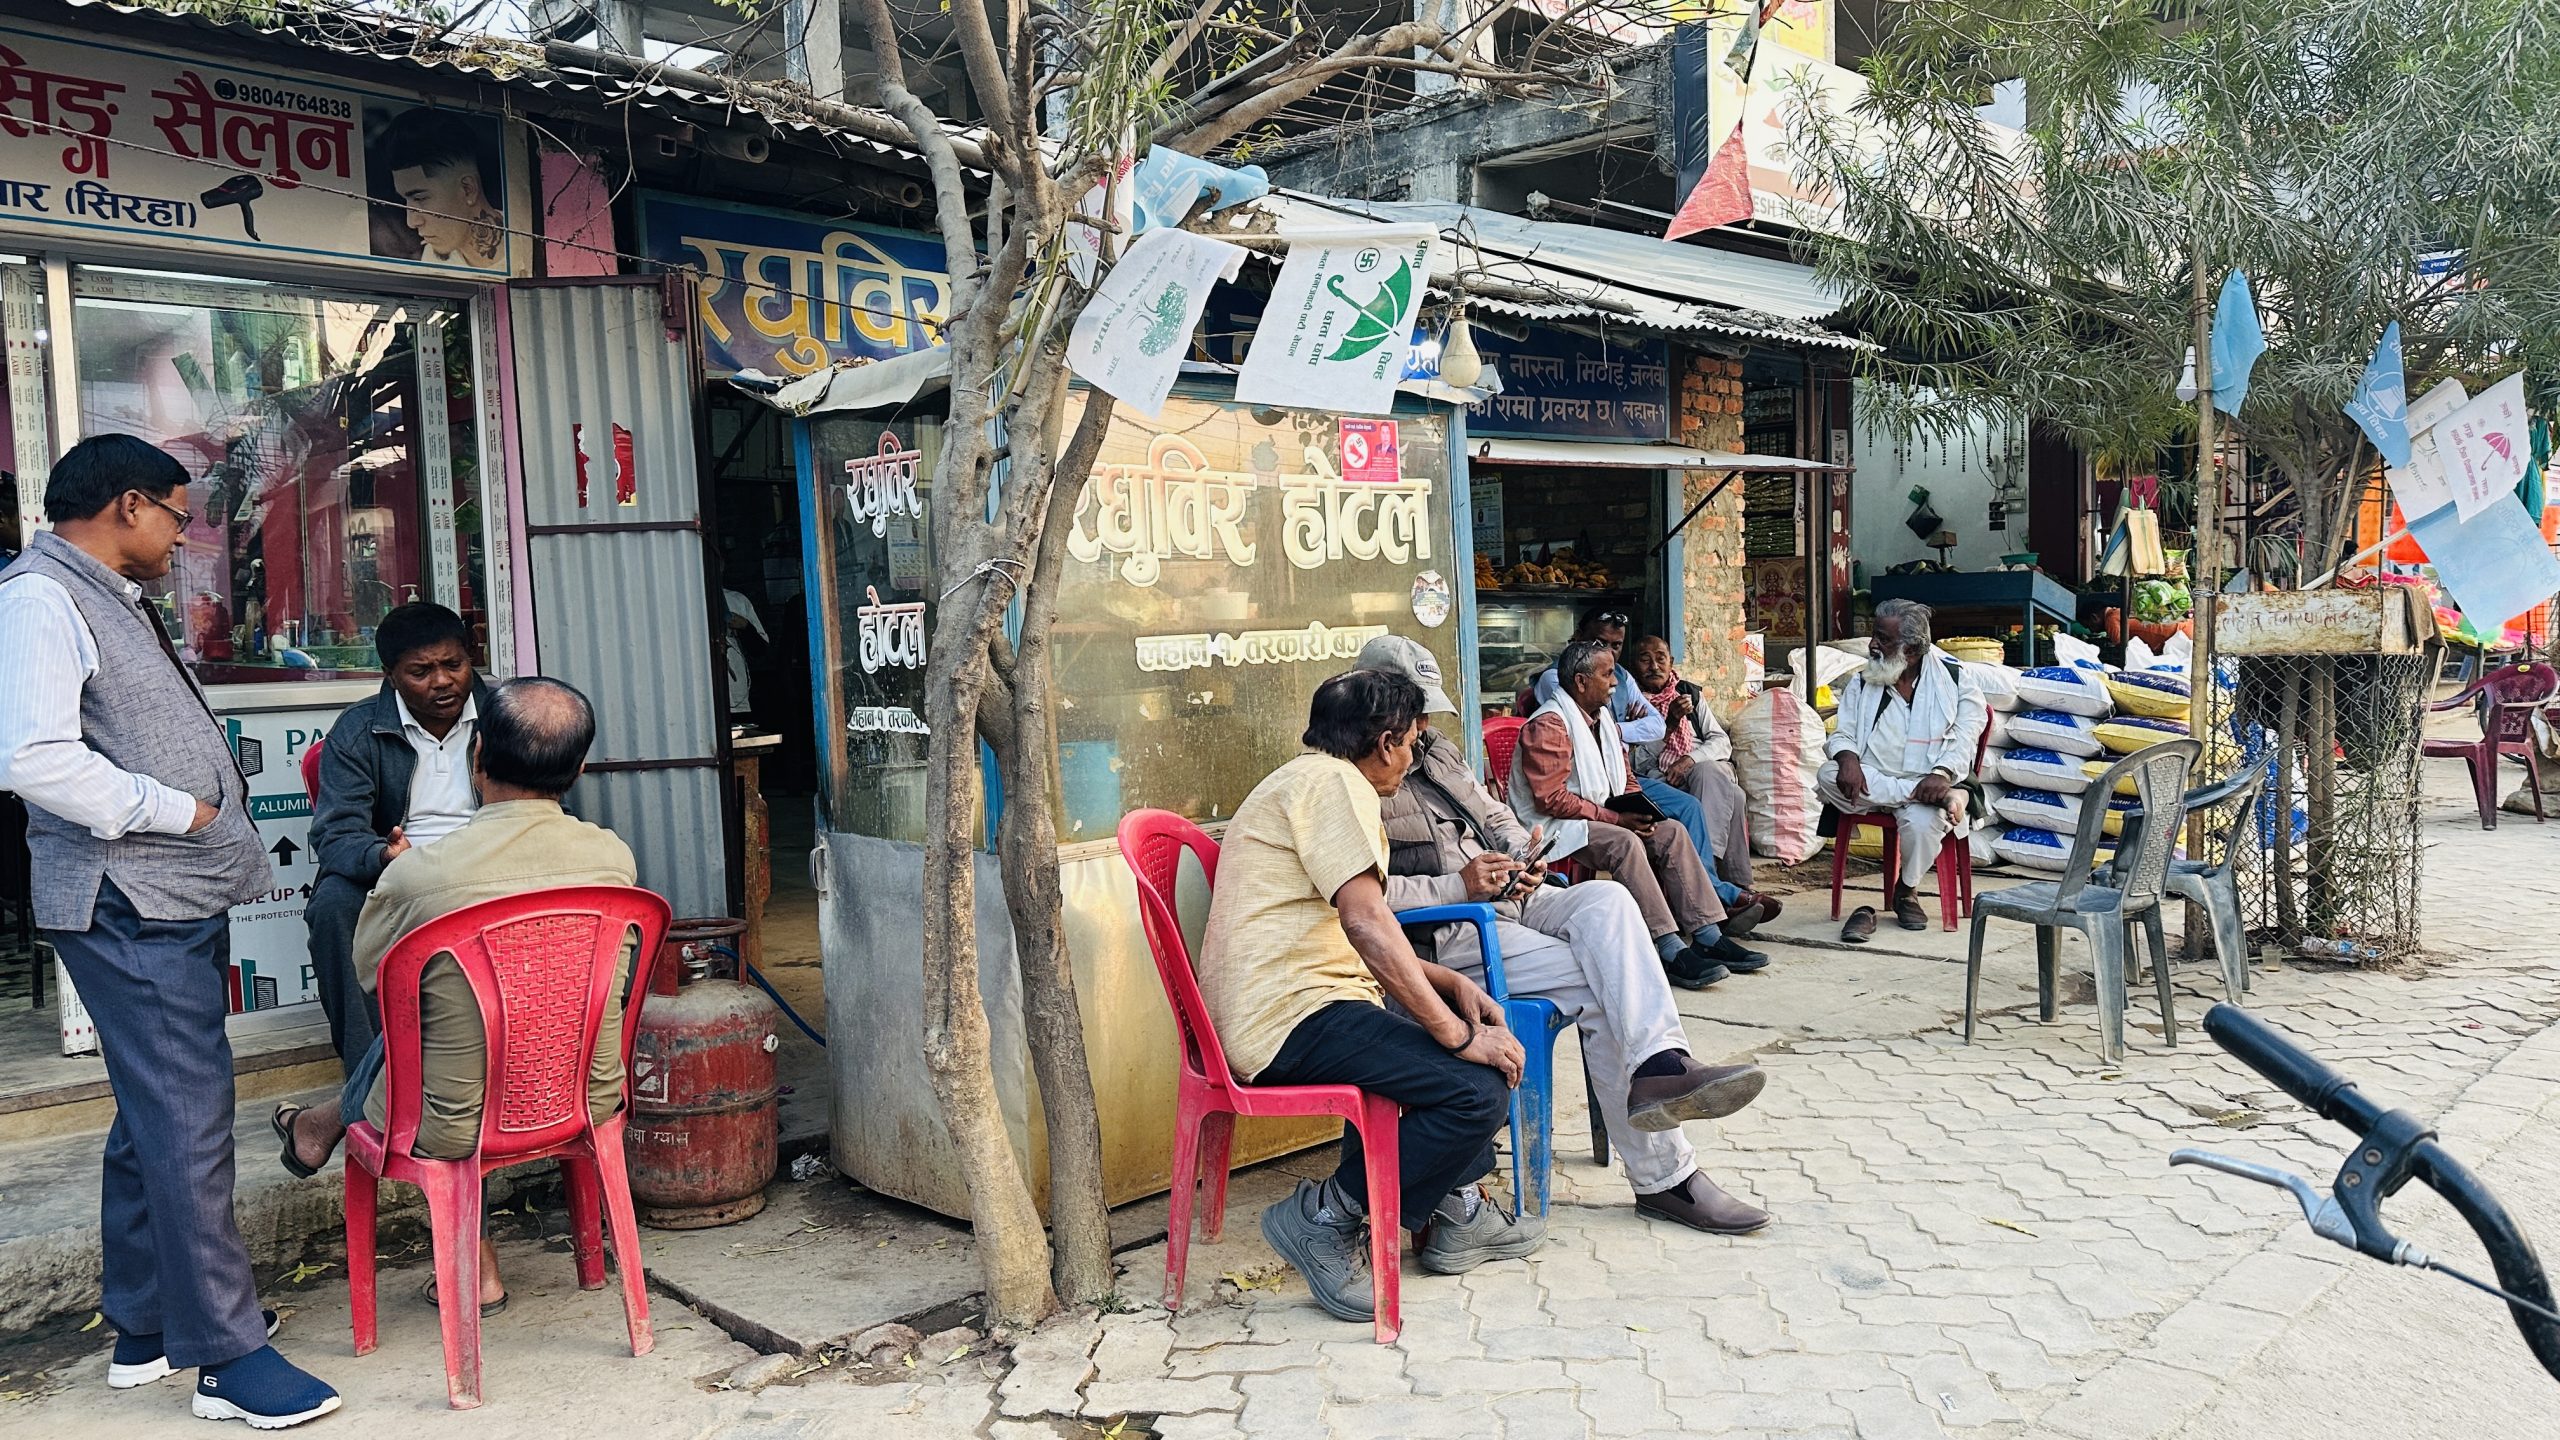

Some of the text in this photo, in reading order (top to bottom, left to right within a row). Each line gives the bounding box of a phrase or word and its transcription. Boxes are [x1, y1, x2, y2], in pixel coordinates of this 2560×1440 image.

[239, 84, 351, 118] 9804764838
[152, 71, 354, 189] सैलुन
[65, 180, 197, 228] (सिरहा)
[1413, 239, 1430, 270] चुनाव
[1308, 310, 1335, 366] छाता छाप
[1279, 447, 1432, 570] होटल
[857, 584, 927, 674] होटल
[1244, 621, 1328, 665] तरकारी
[1331, 625, 1389, 658] बजा
[271, 888, 295, 902] UP
[236, 914, 253, 924] THE
